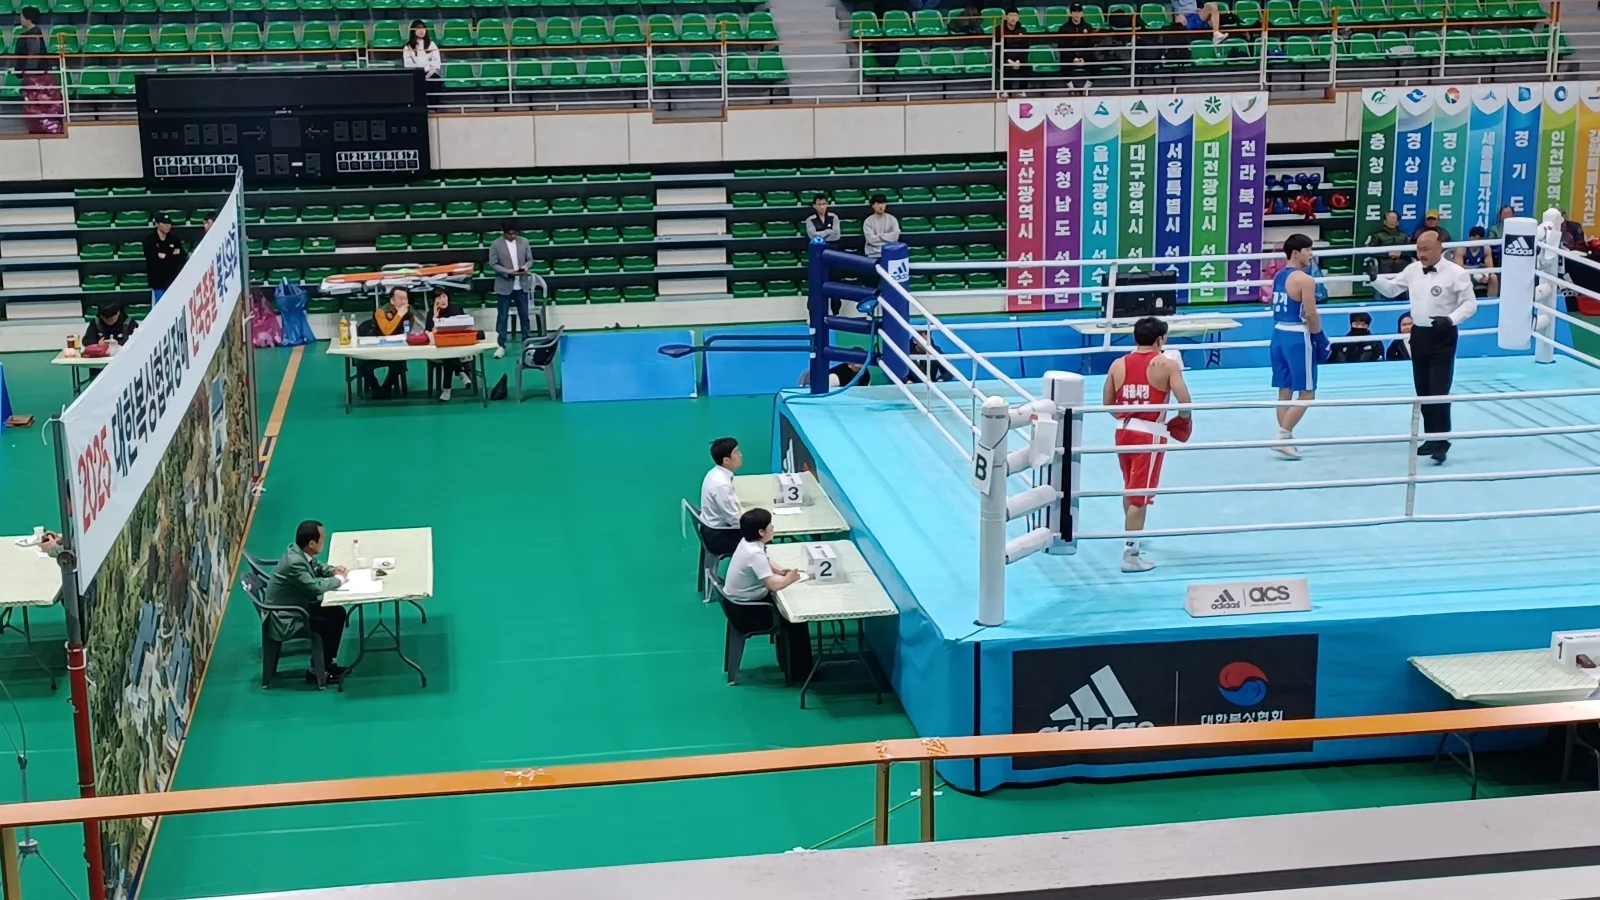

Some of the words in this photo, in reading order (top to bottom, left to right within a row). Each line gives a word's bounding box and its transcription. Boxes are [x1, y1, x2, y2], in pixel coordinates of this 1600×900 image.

[1018, 148, 1034, 239] 부산광역시
[1055, 147, 1072, 237] 충청남도
[1092, 146, 1109, 236] 울산광역시
[1128, 144, 1146, 235] 대구광역시
[1165, 142, 1183, 233] 서울특별시
[1202, 141, 1220, 231] 대전광역시
[1237, 140, 1256, 229] 전라북도
[1365, 133, 1386, 221] 충청북도
[1401, 132, 1422, 220] 경상북도
[1438, 132, 1458, 220] 경상남도
[1476, 131, 1495, 229] 세자치시
[1510, 131, 1529, 212] 경기도
[1547, 131, 1565, 208] 인천광역
[1583, 129, 1600, 226] 강원자치도
[1505, 246, 1533, 256] adidas
[77, 424, 112, 535] 2025
[787, 486, 799, 501] 3
[974, 453, 988, 481] B
[819, 560, 833, 577] 2
[1210, 600, 1241, 610] adidas
[1248, 584, 1291, 603] acs
[1557, 641, 1564, 660] 1
